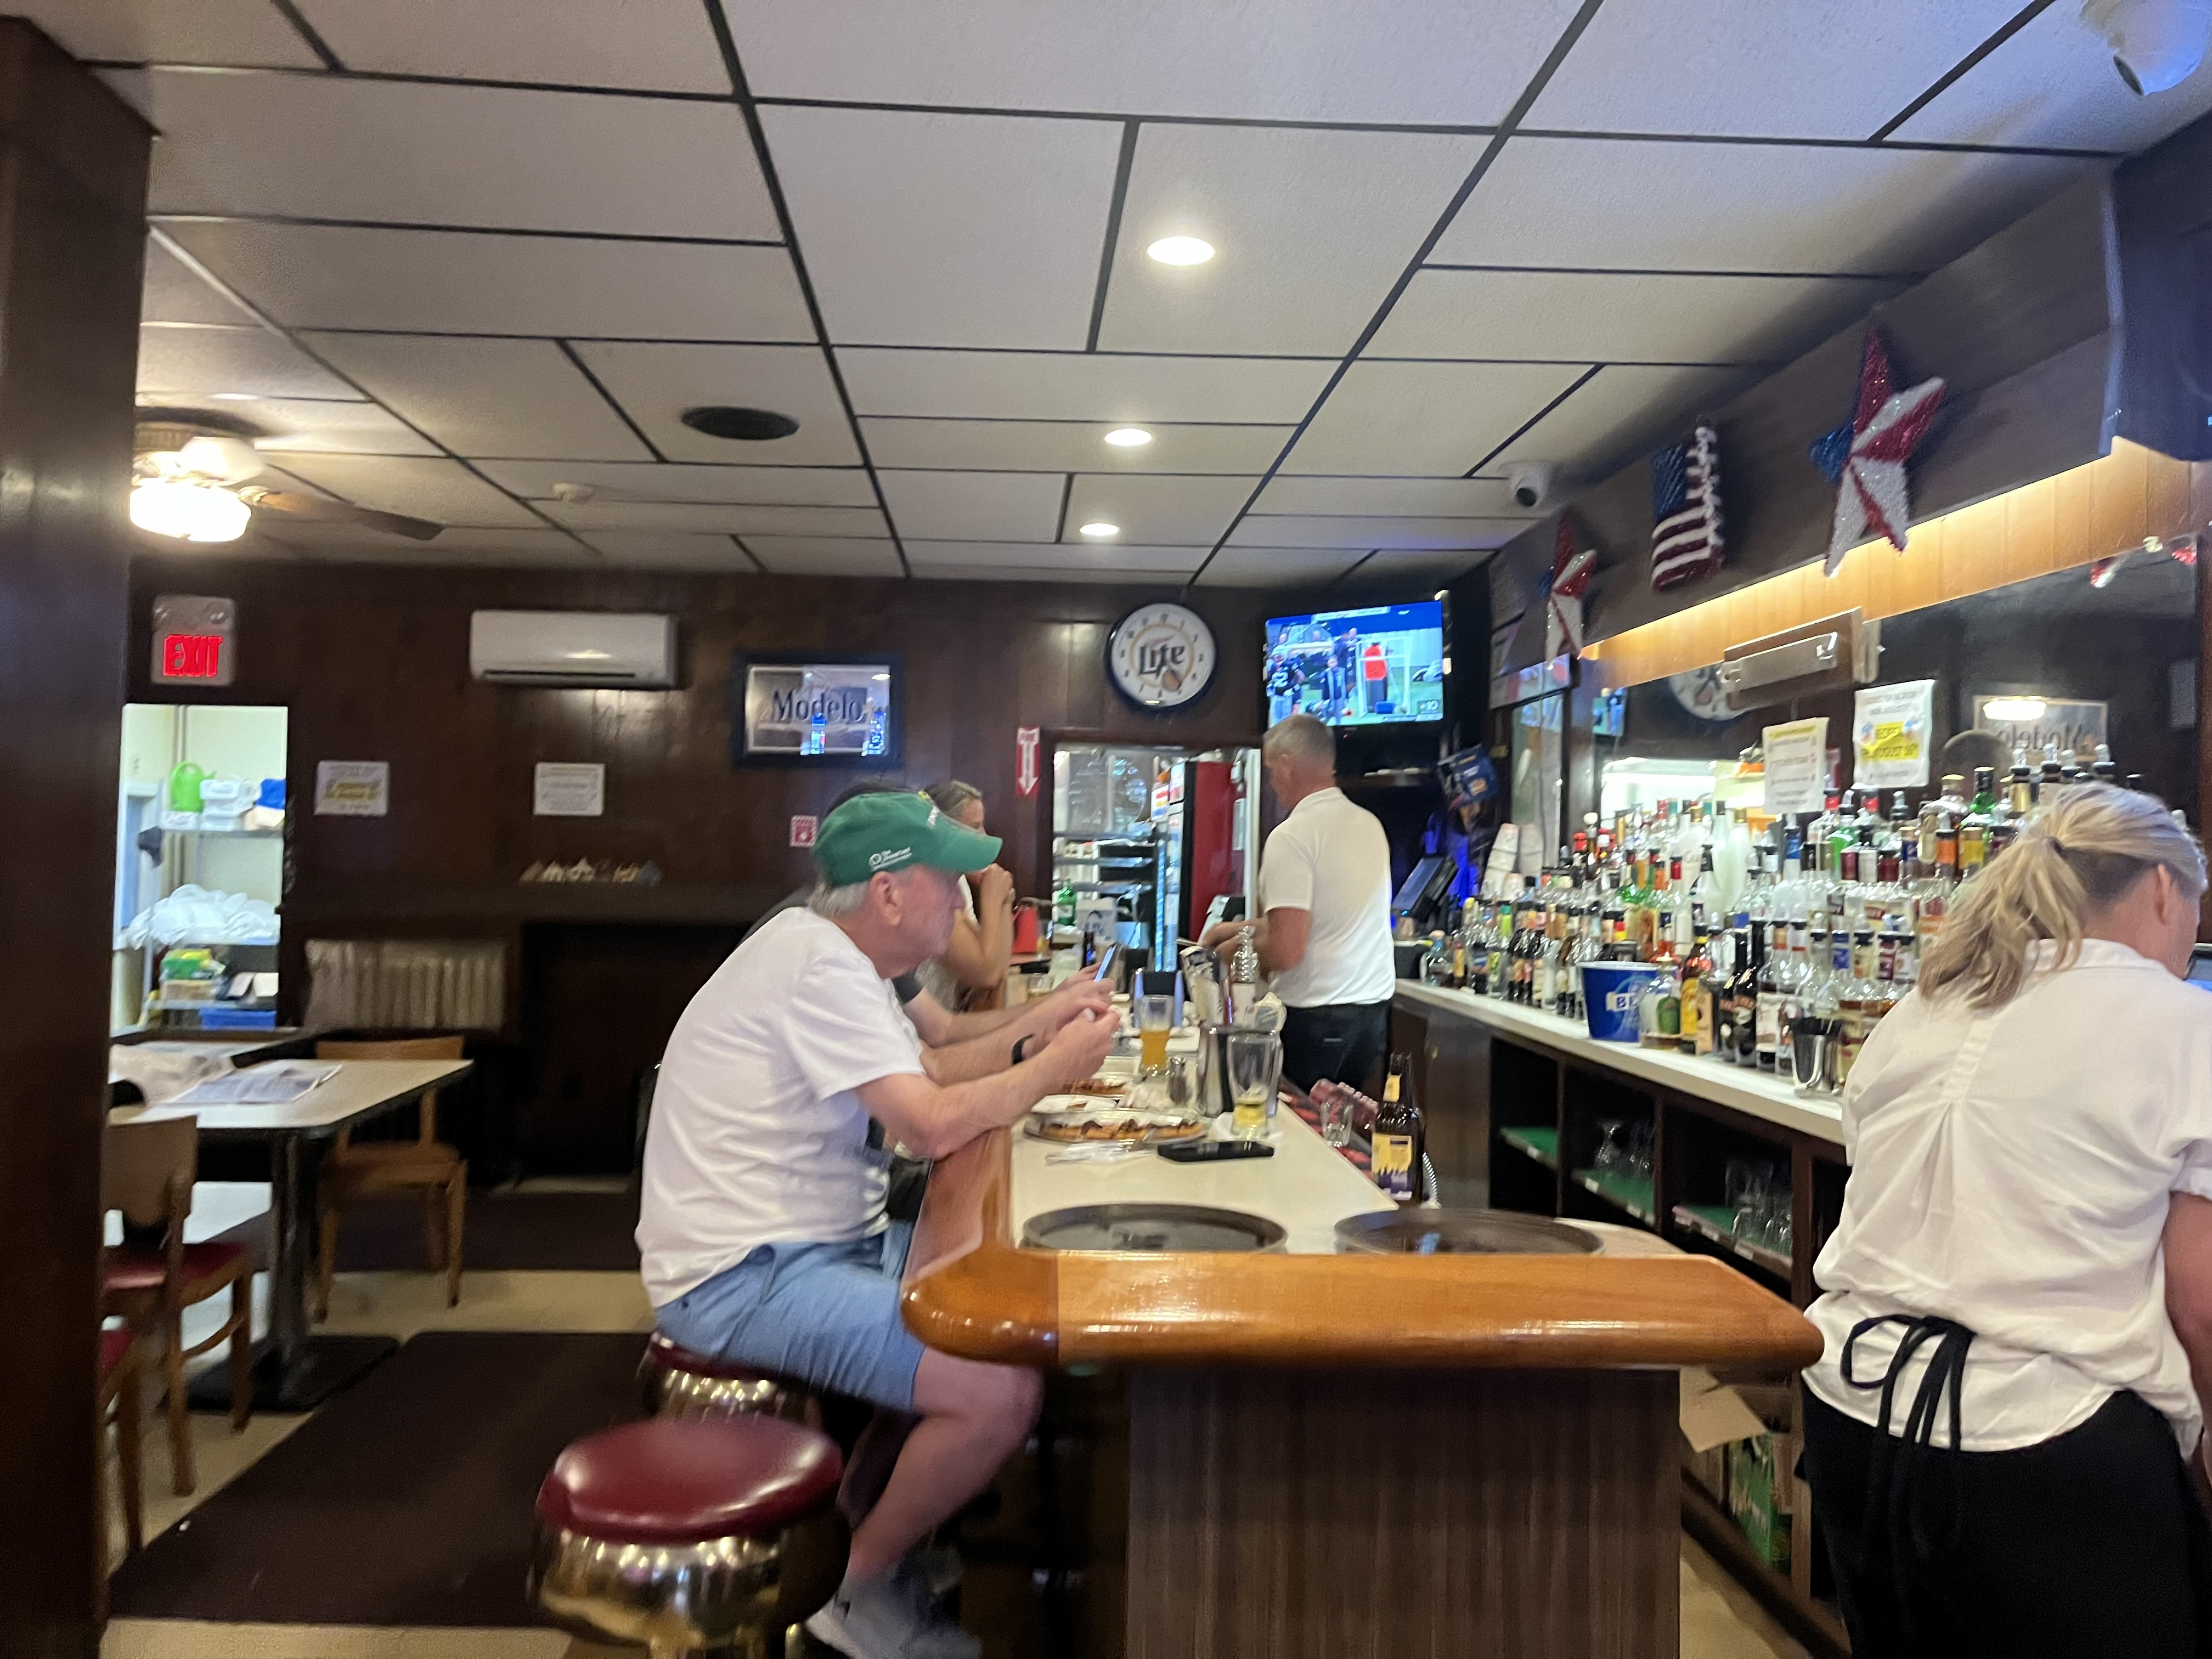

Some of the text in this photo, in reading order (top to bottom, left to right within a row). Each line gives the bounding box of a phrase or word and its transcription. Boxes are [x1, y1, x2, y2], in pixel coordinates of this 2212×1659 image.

[163, 634, 223, 677] EXIT
[1139, 644, 1186, 678] Lite
[771, 690, 864, 723] Modelo
